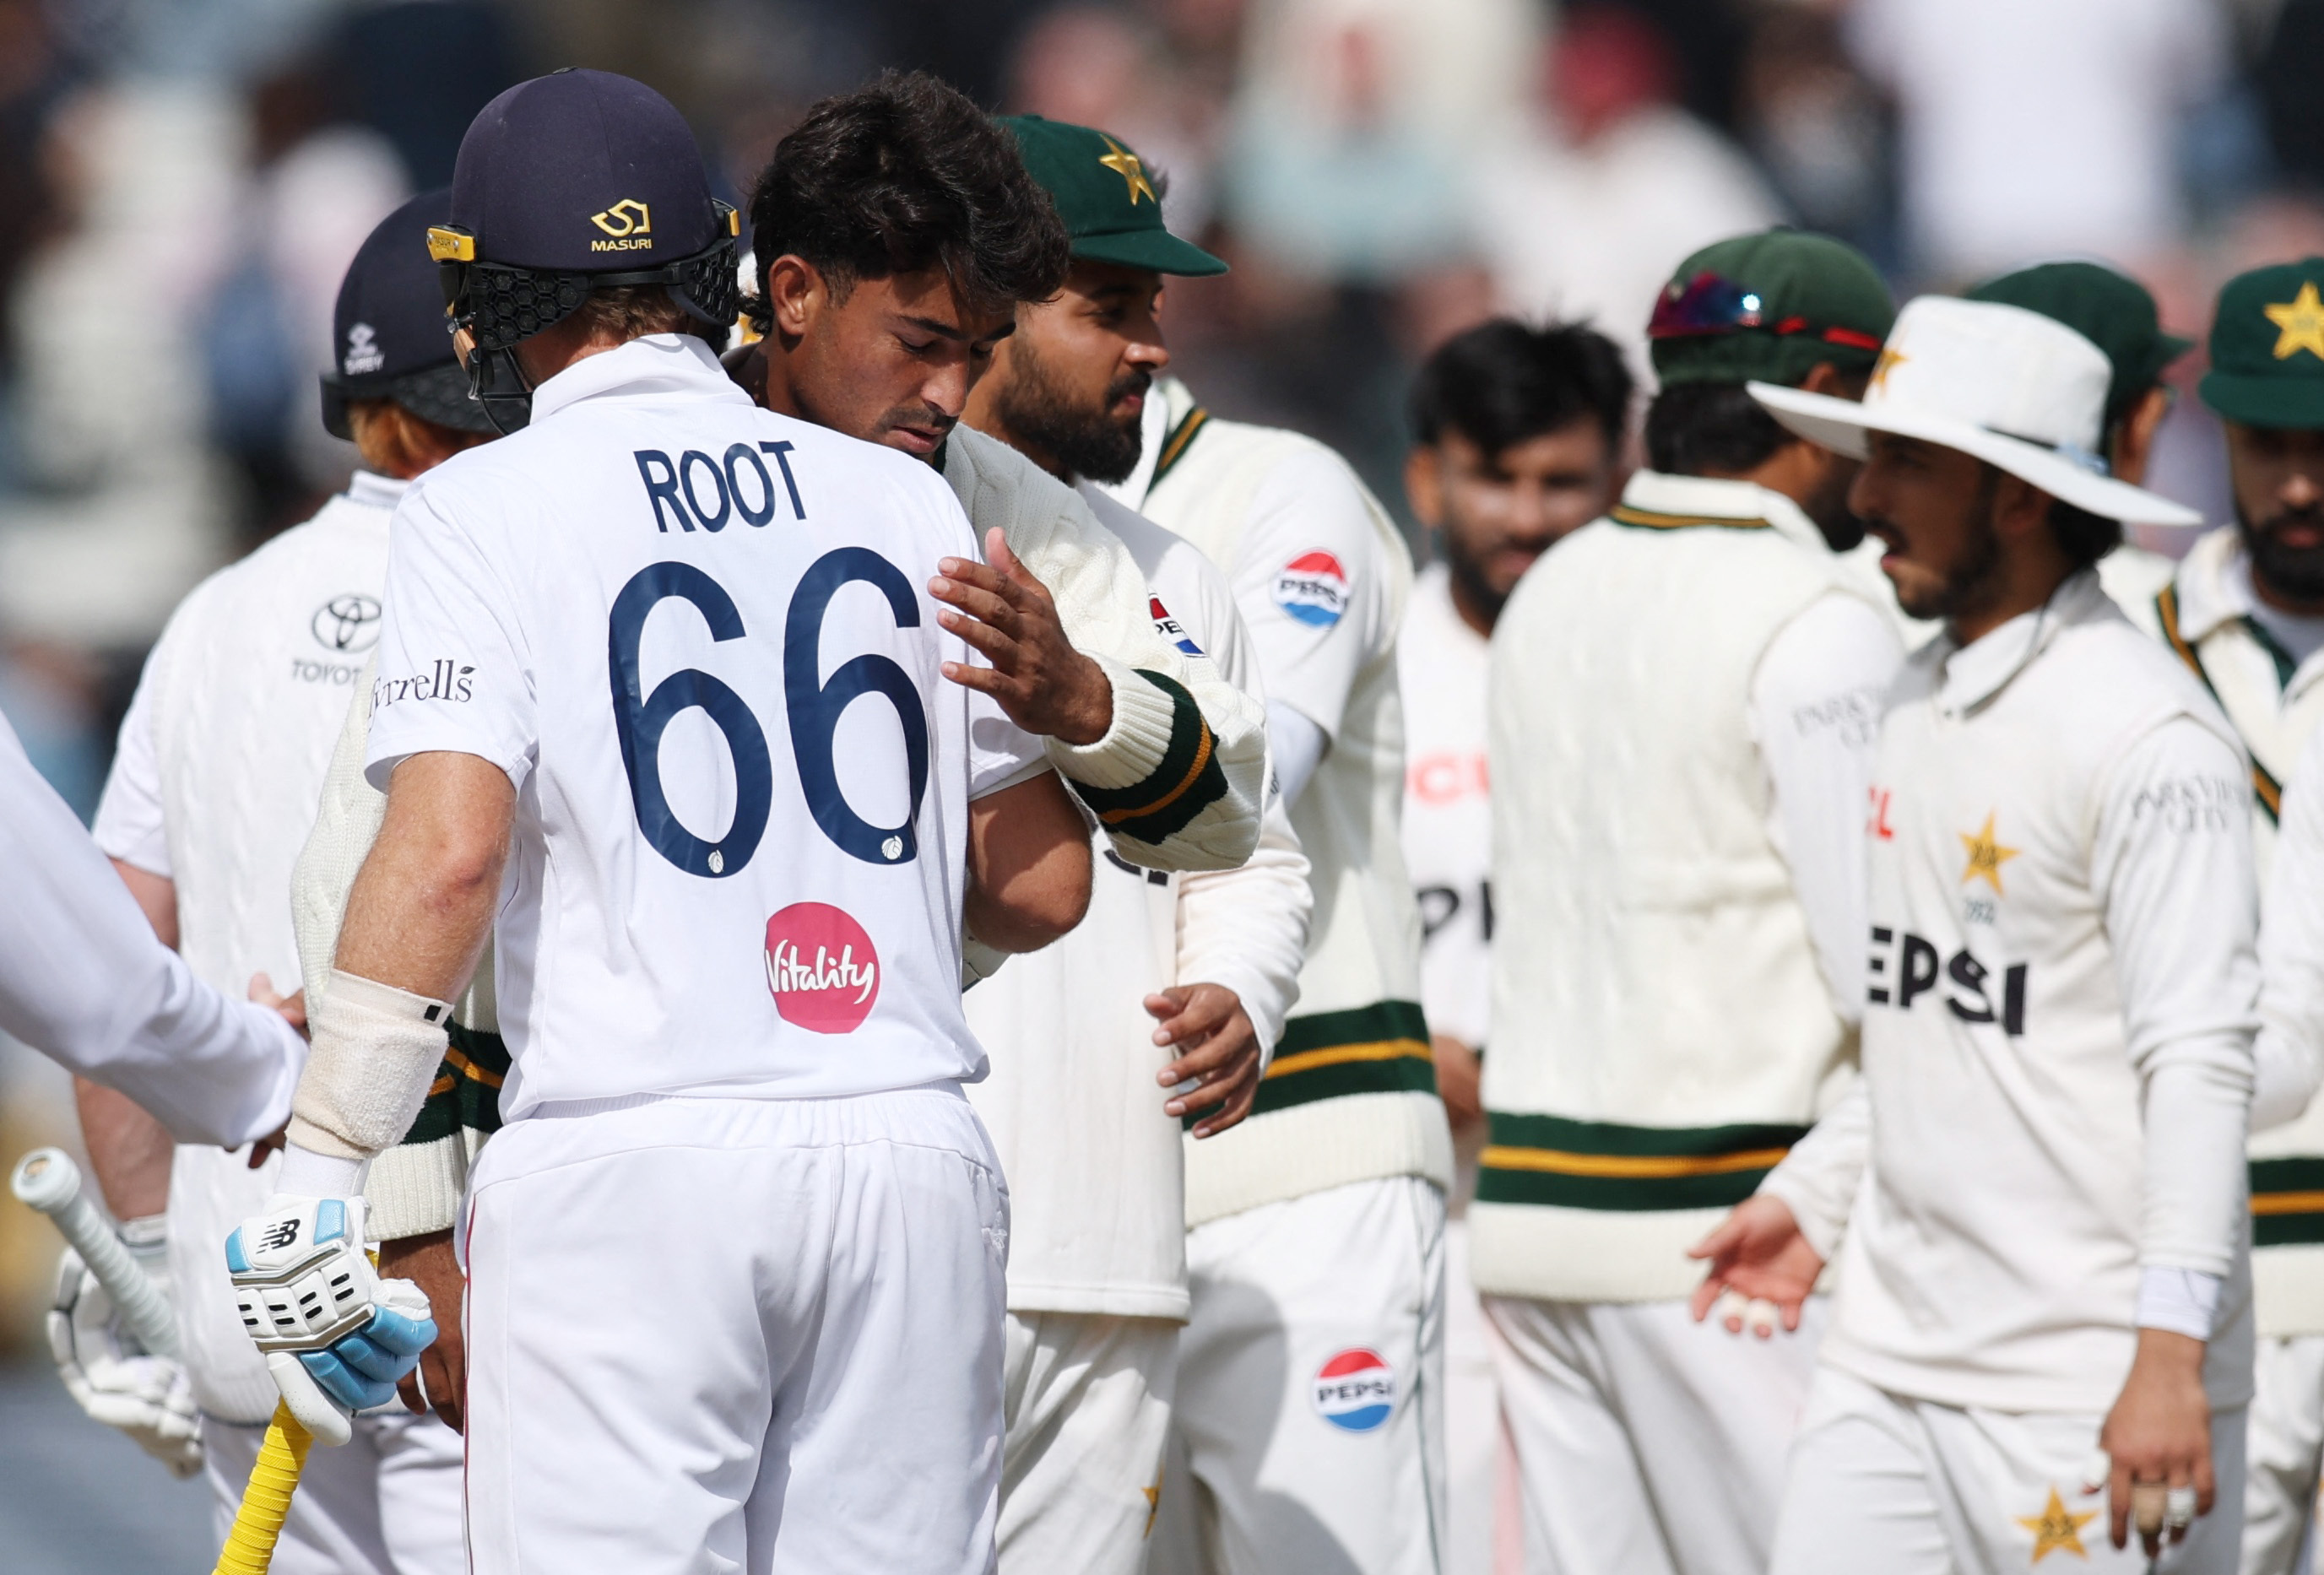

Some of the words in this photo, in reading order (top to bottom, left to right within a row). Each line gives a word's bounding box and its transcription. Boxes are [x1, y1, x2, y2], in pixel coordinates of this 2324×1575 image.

[591, 238, 652, 252] MASURI
[634, 441, 807, 534] ROOT
[292, 657, 363, 686] TOYOT
[609, 546, 929, 879] 66
[766, 939, 875, 1004] Vitality
[1866, 925, 2028, 1036] EPSI
[1318, 1381, 1392, 1402] PEPSI
